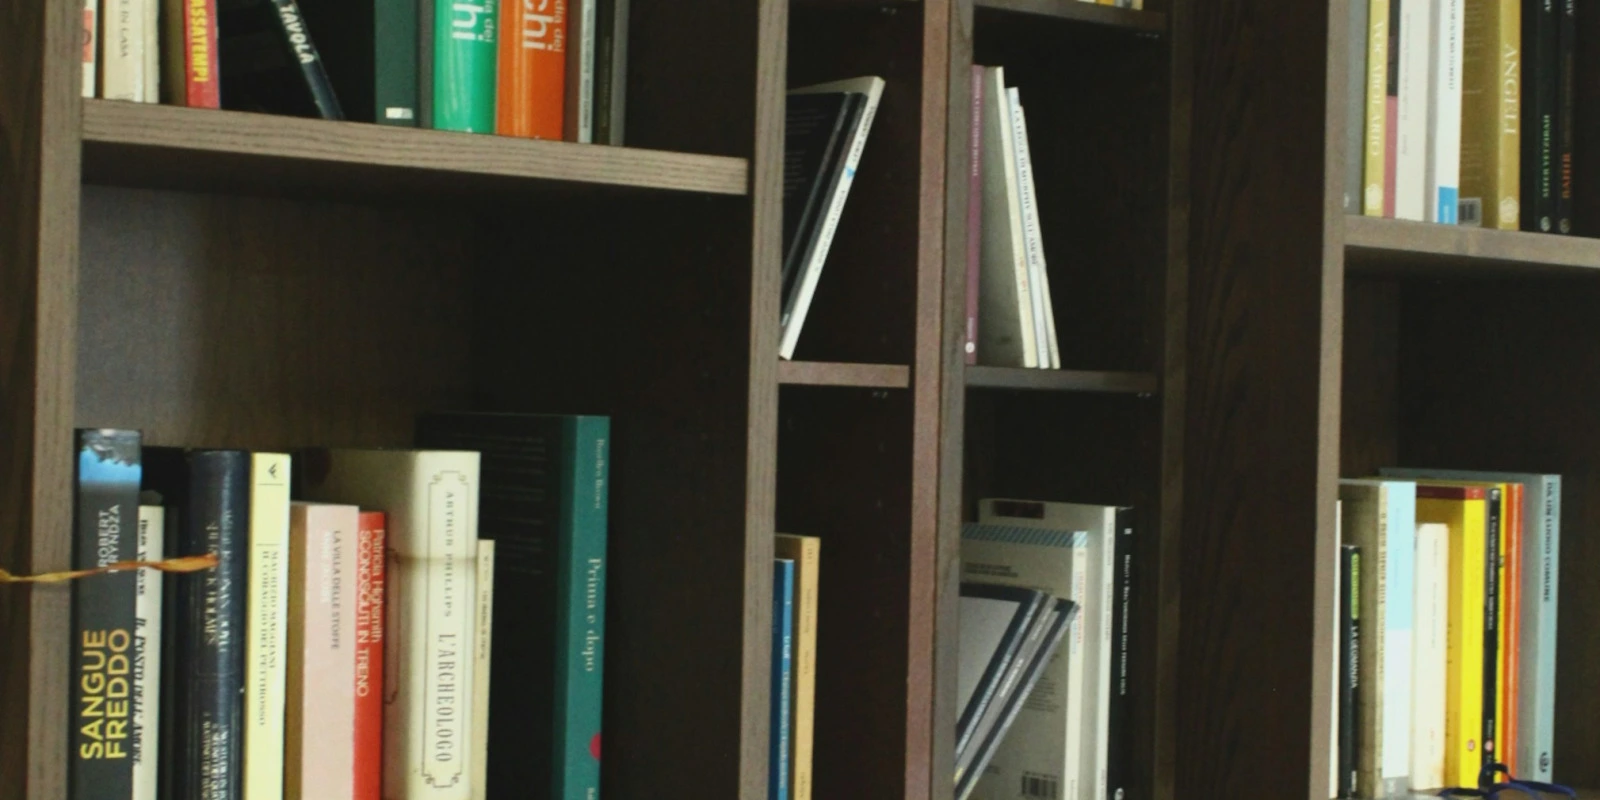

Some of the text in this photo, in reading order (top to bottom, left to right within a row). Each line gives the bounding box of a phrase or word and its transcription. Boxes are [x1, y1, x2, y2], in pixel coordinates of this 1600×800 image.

[279, 3, 315, 64] TAVOLA
[483, 18, 495, 43] dei
[553, 28, 565, 53] dei
[1370, 20, 1385, 155] VOCABOLARIO
[1503, 43, 1519, 134] ANGELI
[1545, 499, 1553, 515] UN
[1546, 481, 1553, 497] DA
[98, 509, 110, 568] ROBERT
[107, 504, 121, 574] RYNDZA
[443, 491, 455, 618] ARTHUR PHILLIPS
[1543, 556, 1551, 602] COMUNE
[331, 530, 342, 650] LA VILLA DELLE STOFFE
[357, 530, 372, 697] SCONOSCIUTI IN TRENO
[367, 529, 384, 643] Patricia Highsmith
[580, 557, 603, 672] Prima e dopo
[1350, 625, 1358, 638] LA
[257, 550, 270, 726] IL CORAGGIO DEL PETTIROSSO
[1349, 638, 1359, 688] GEOMANZIA
[80, 629, 107, 759] SANGUE
[105, 628, 130, 759] FREDDO
[435, 634, 457, 764] L'ARCHEOLOGO
